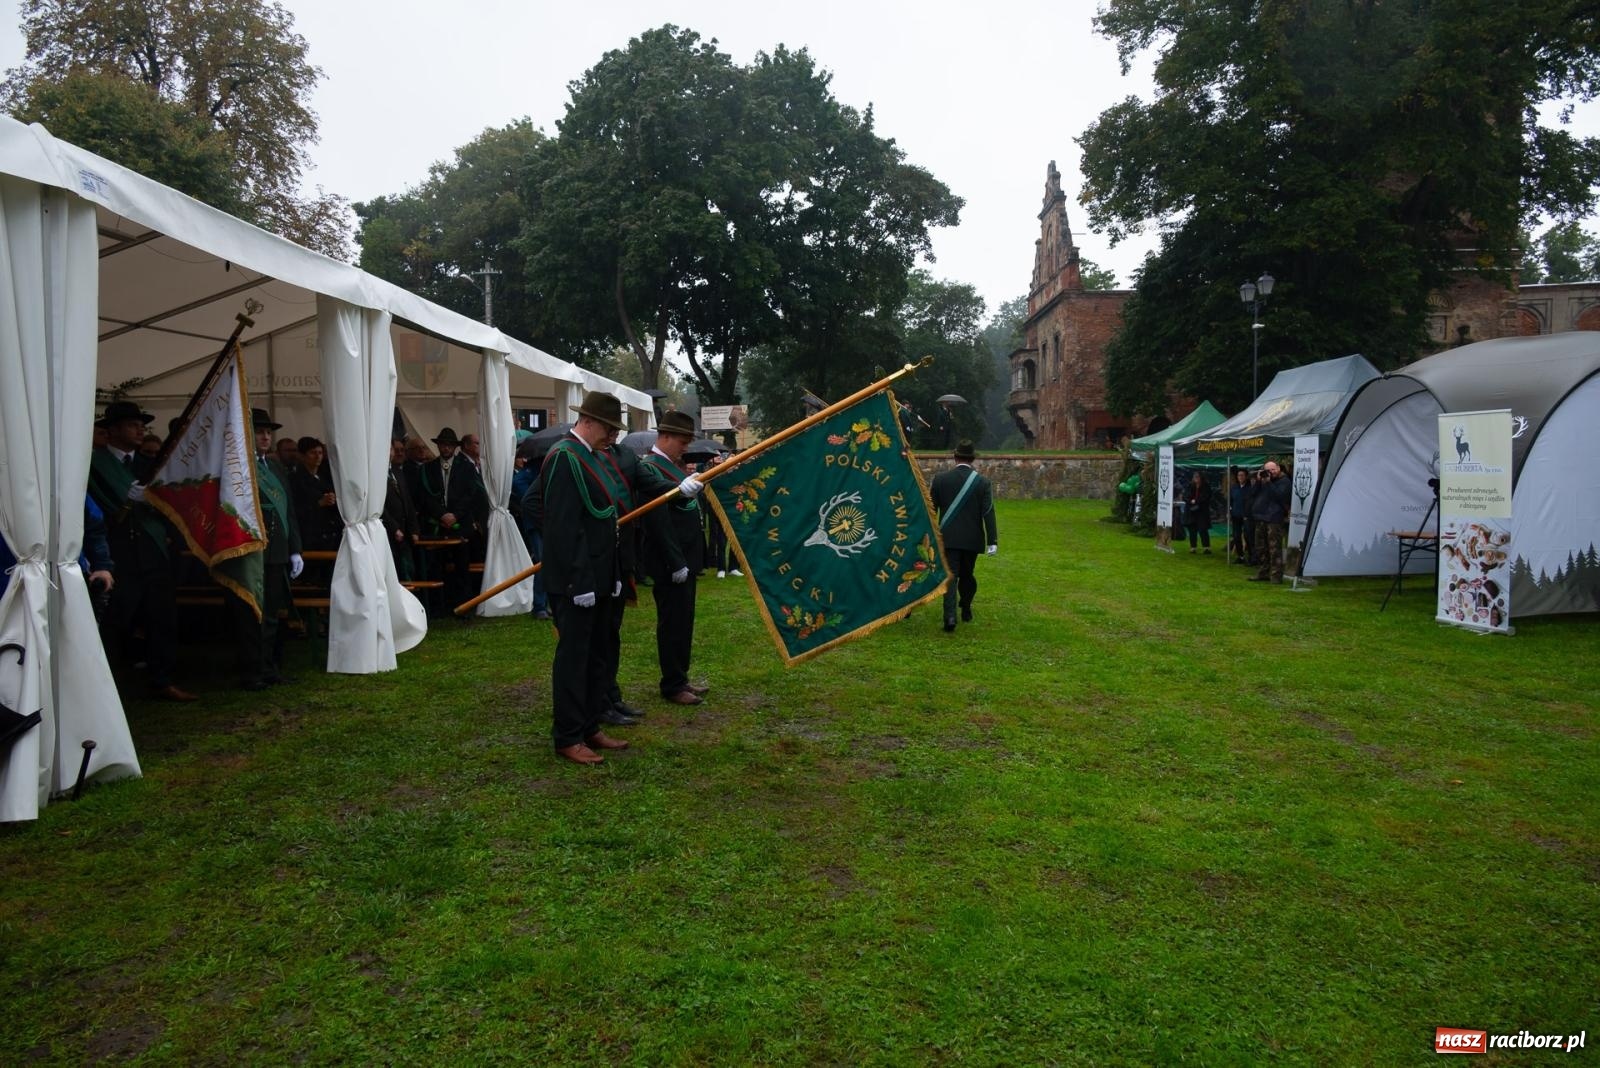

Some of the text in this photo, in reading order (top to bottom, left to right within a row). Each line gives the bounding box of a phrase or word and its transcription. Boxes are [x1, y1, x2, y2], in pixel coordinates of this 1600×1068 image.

[825, 454, 891, 485] POLSKI
[767, 486, 833, 603] ŁOWIECKI
[875, 491, 909, 583] ZWIĄZEK
